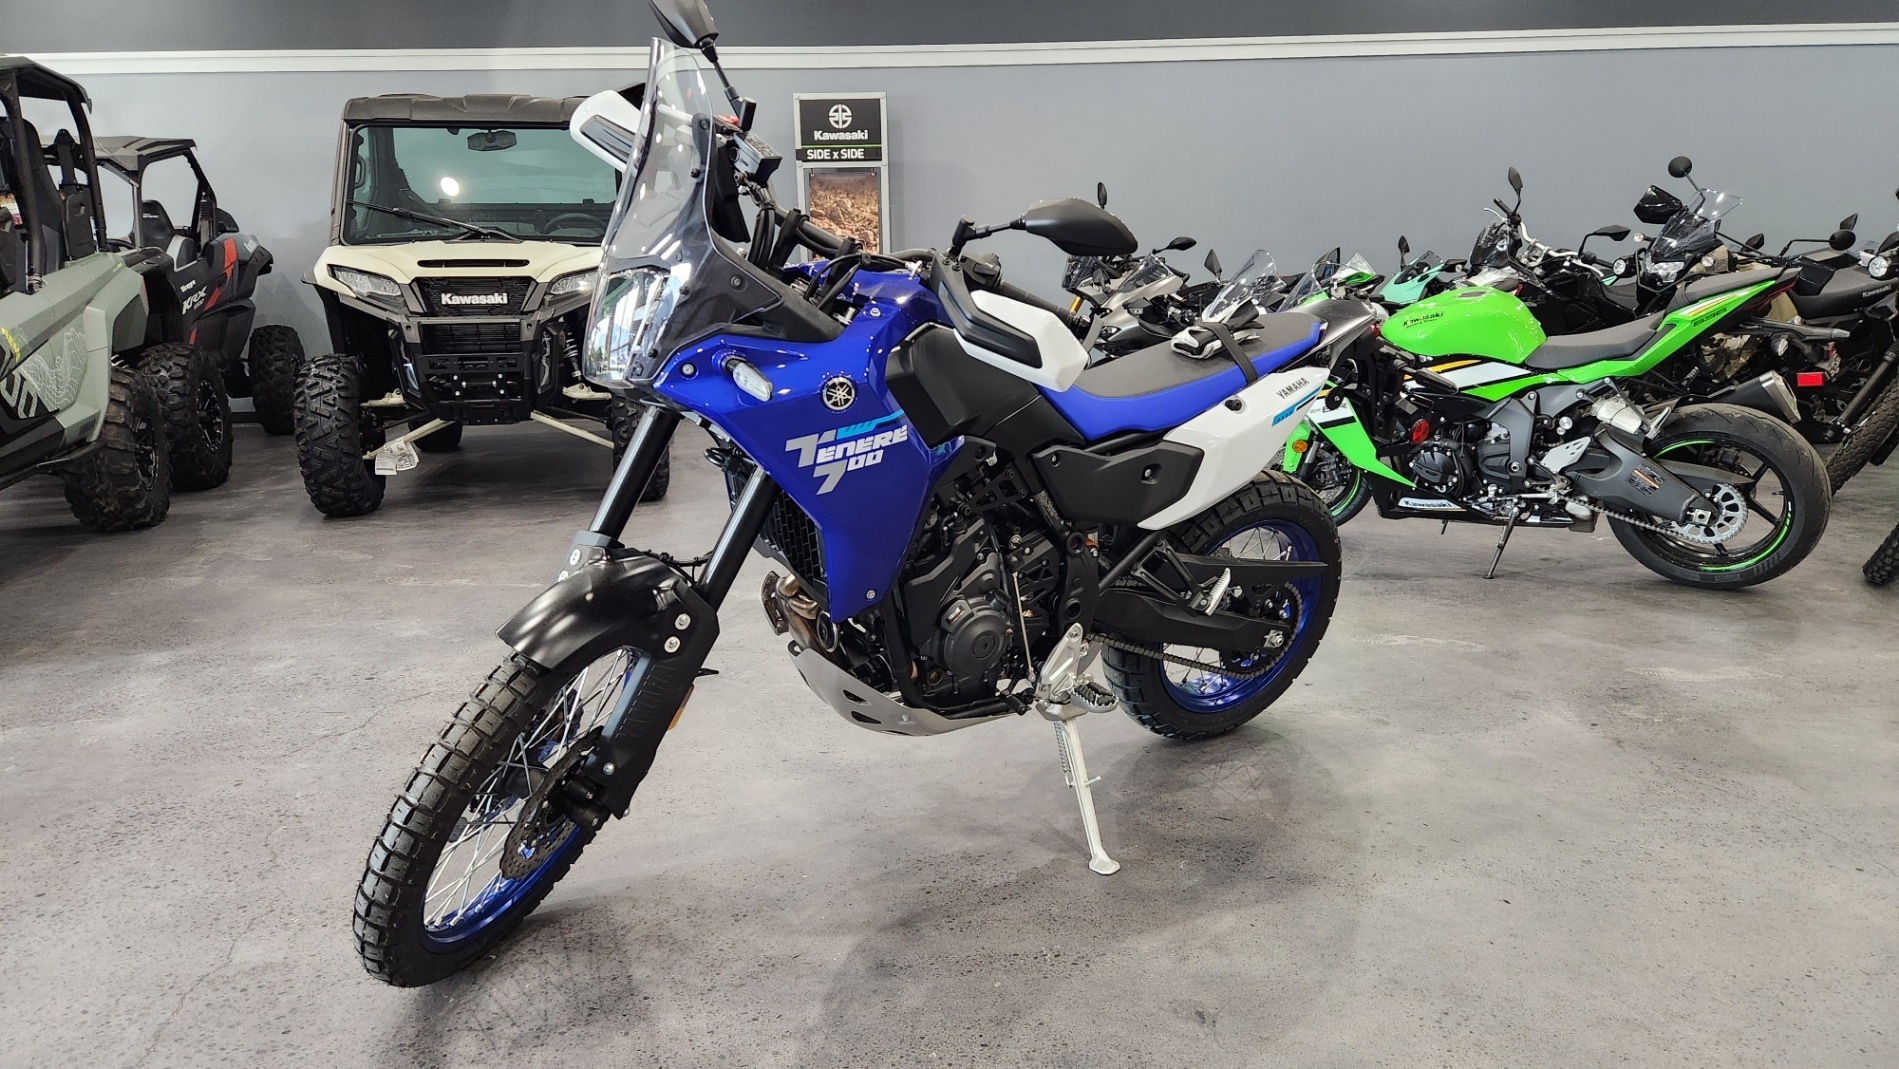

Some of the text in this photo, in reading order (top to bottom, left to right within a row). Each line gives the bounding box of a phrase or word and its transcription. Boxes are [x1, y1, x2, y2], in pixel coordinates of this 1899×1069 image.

[814, 130, 868, 140] Kawasaki
[807, 148, 865, 160] SIDE x SIDE
[1862, 284, 1892, 298] Kawasaki
[182, 285, 208, 315] KRX
[441, 292, 508, 305] Kawasaki
[1276, 377, 1310, 400] YAMAHA
[813, 449, 884, 496] 700
[1403, 499, 1452, 508] Kawasaki
